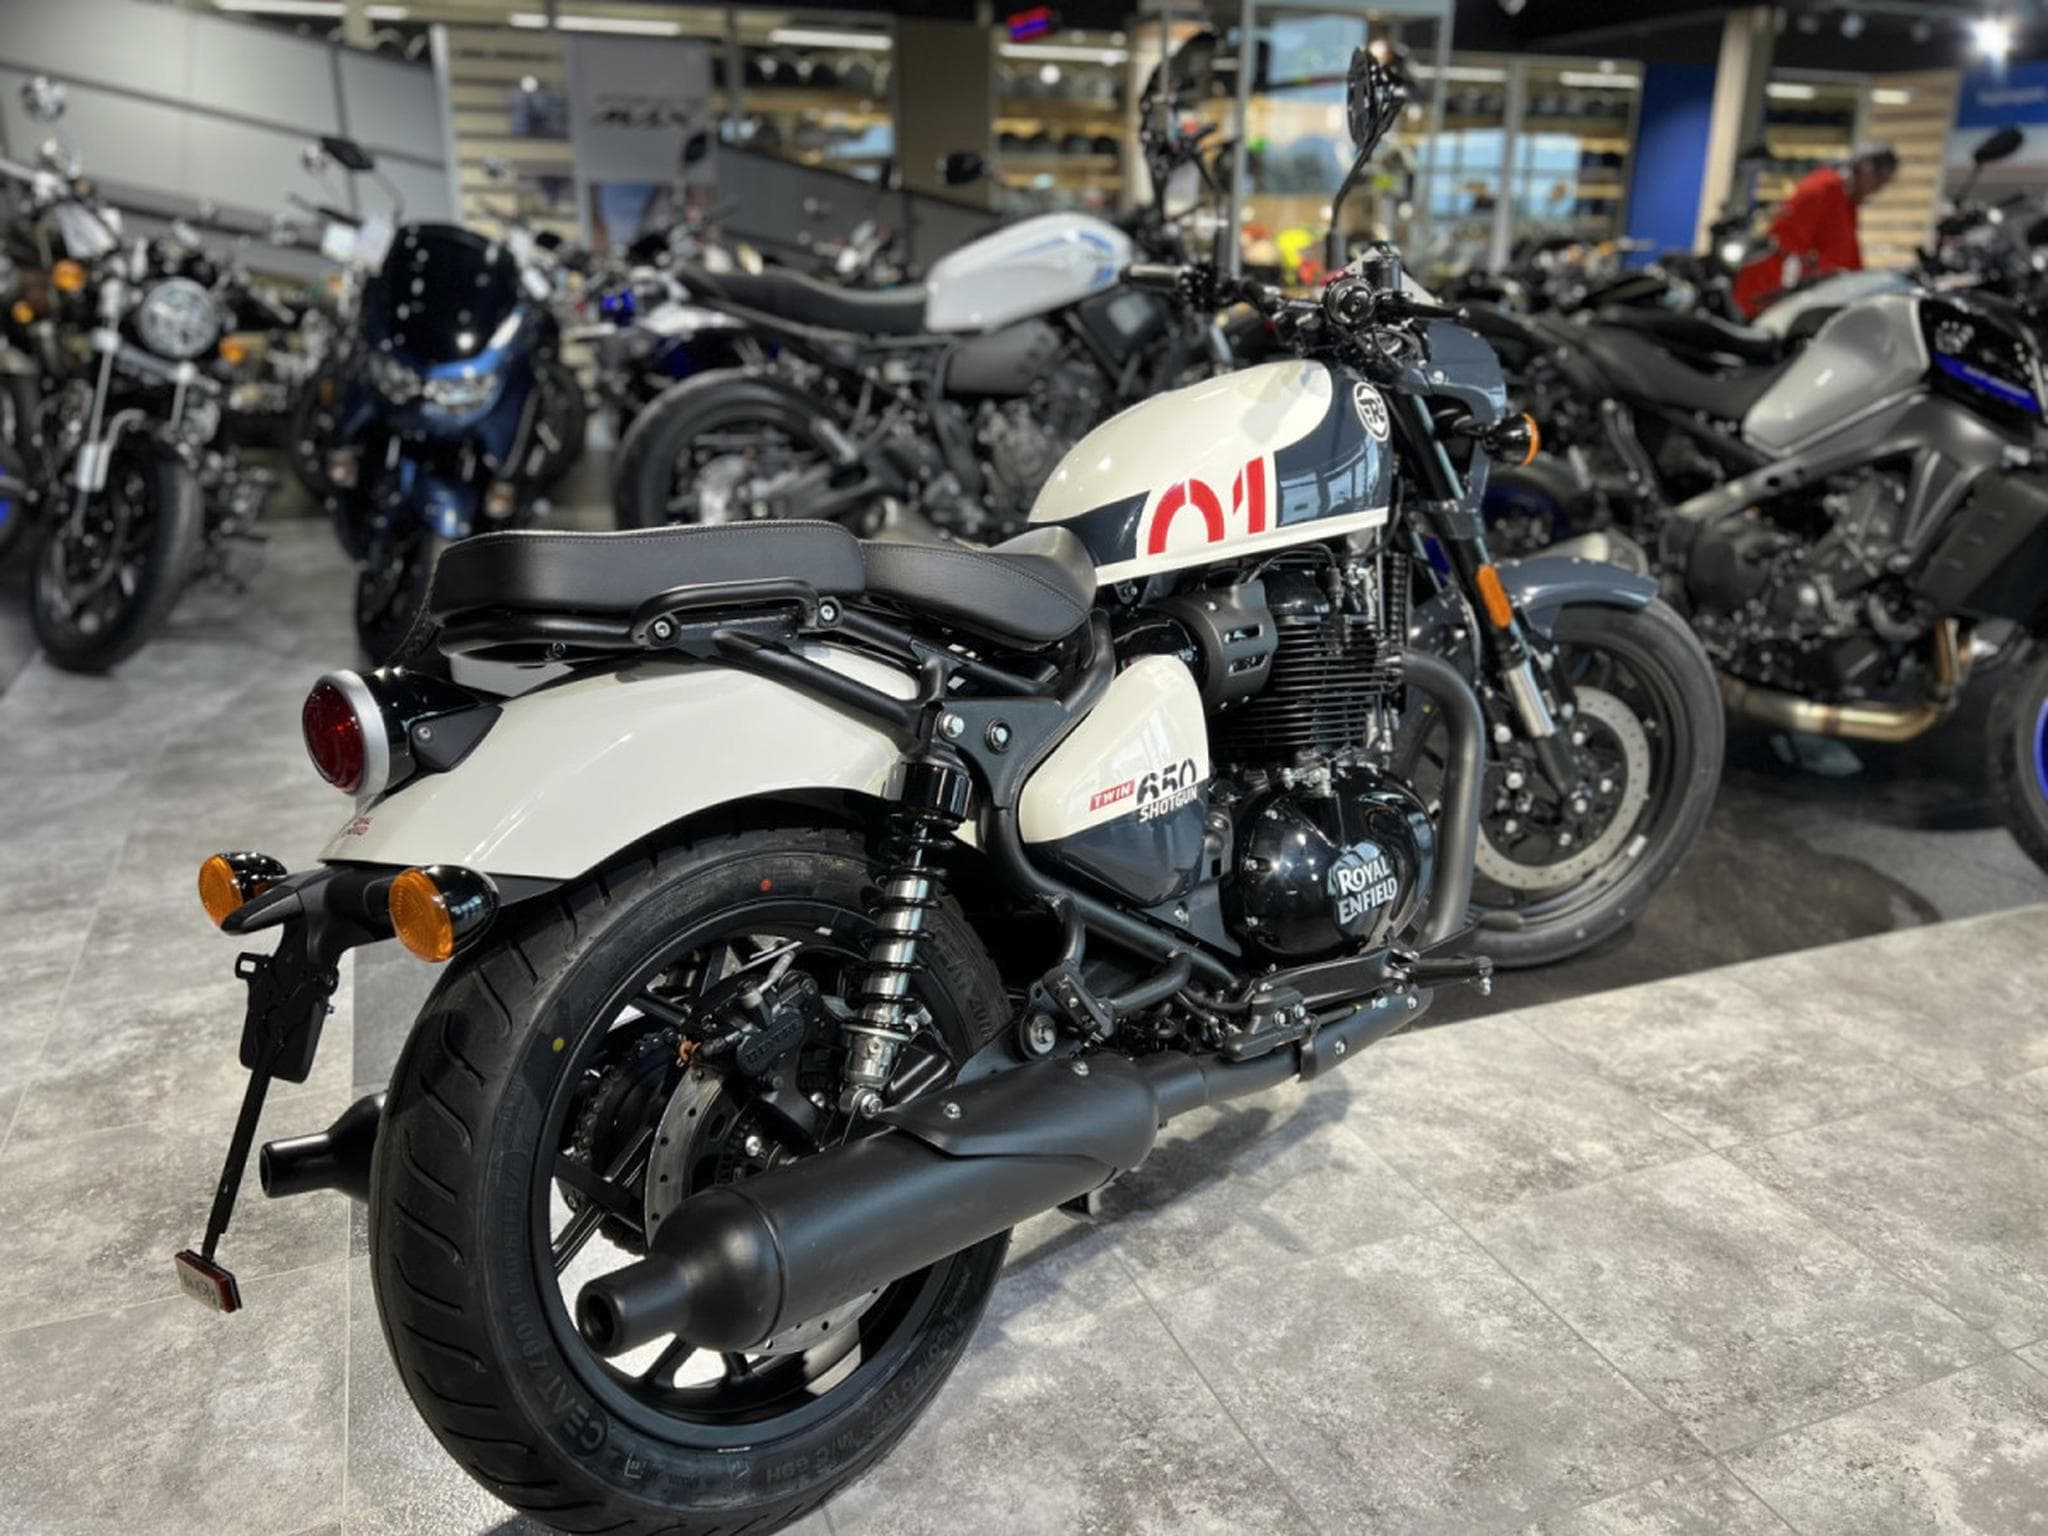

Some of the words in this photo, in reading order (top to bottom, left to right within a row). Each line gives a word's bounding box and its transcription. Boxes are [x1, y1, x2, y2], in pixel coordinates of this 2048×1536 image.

[1147, 456, 1266, 555] 01
[1090, 779, 1136, 812] TWIN
[1137, 757, 1197, 806] 650
[1138, 784, 1198, 823] SHOTGUN
[1337, 855, 1390, 896] ROYAL
[1338, 877, 1398, 925] ENFIELD
[536, 1374, 606, 1450] CEAT
